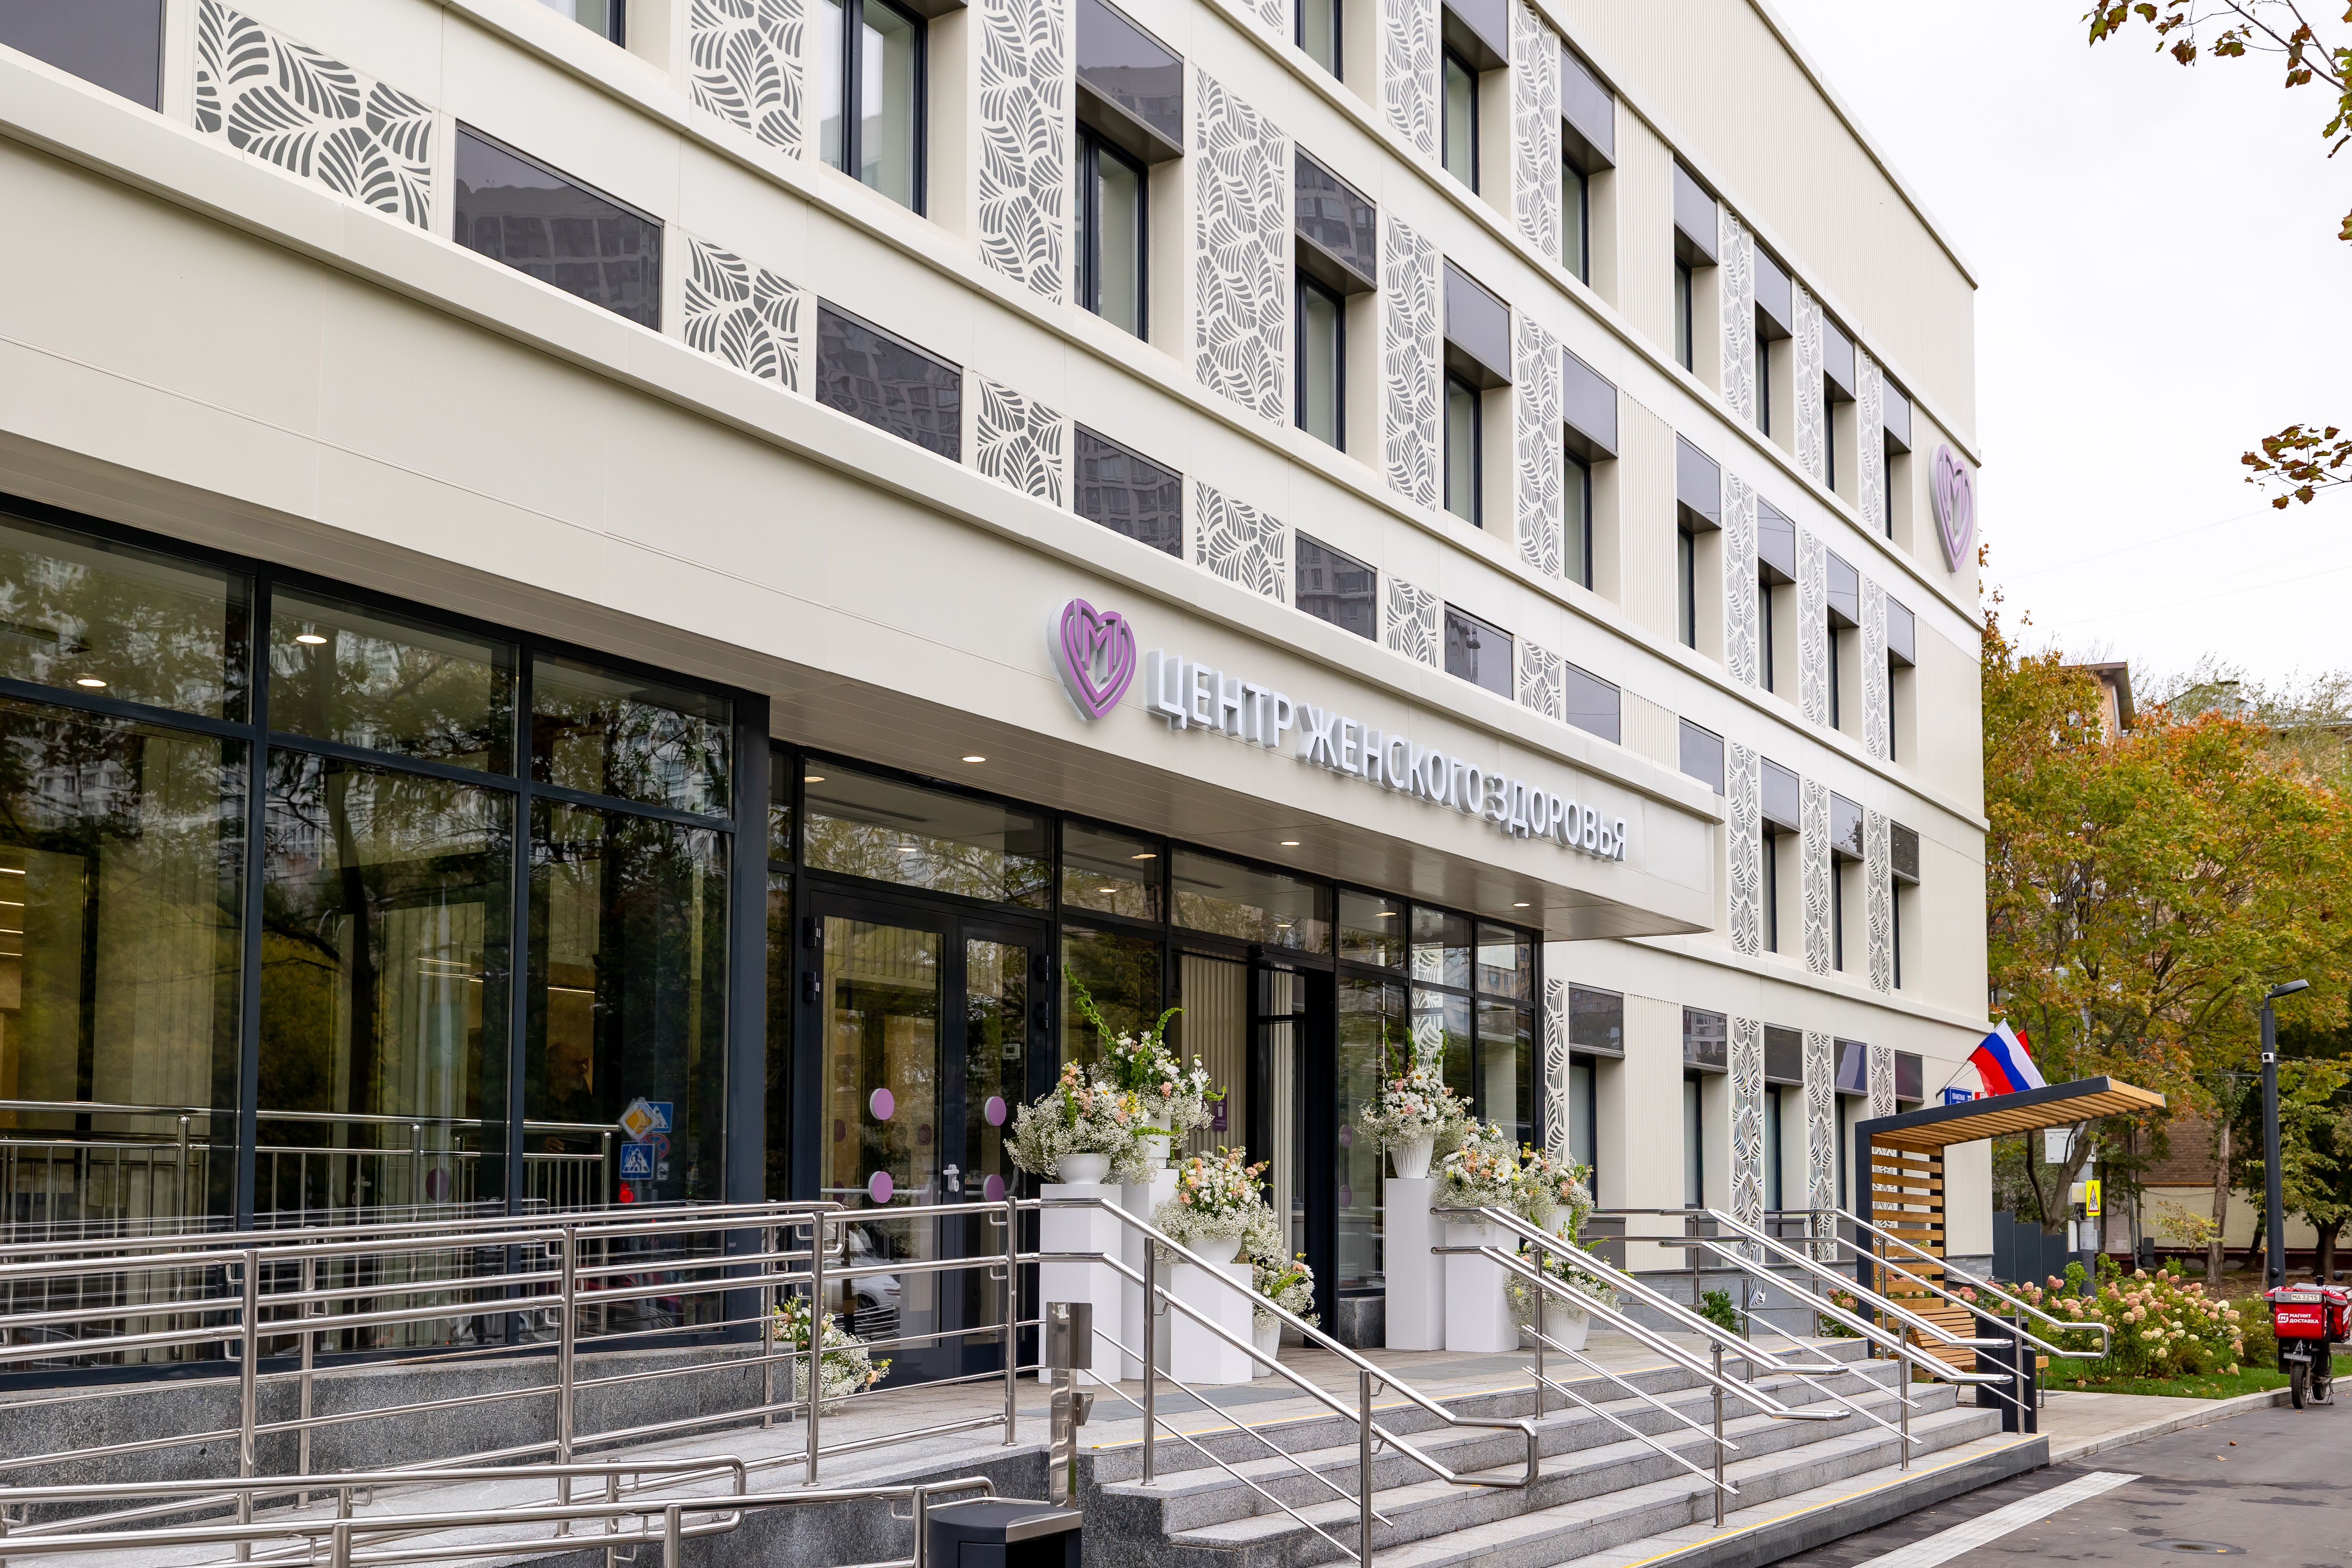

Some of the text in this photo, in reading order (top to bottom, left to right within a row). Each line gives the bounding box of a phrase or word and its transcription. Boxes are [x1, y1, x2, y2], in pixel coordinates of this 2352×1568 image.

[1149, 648, 1626, 862] ЦЕНТР ЖЕНСКОГО ЗДОРОВЬЯ
